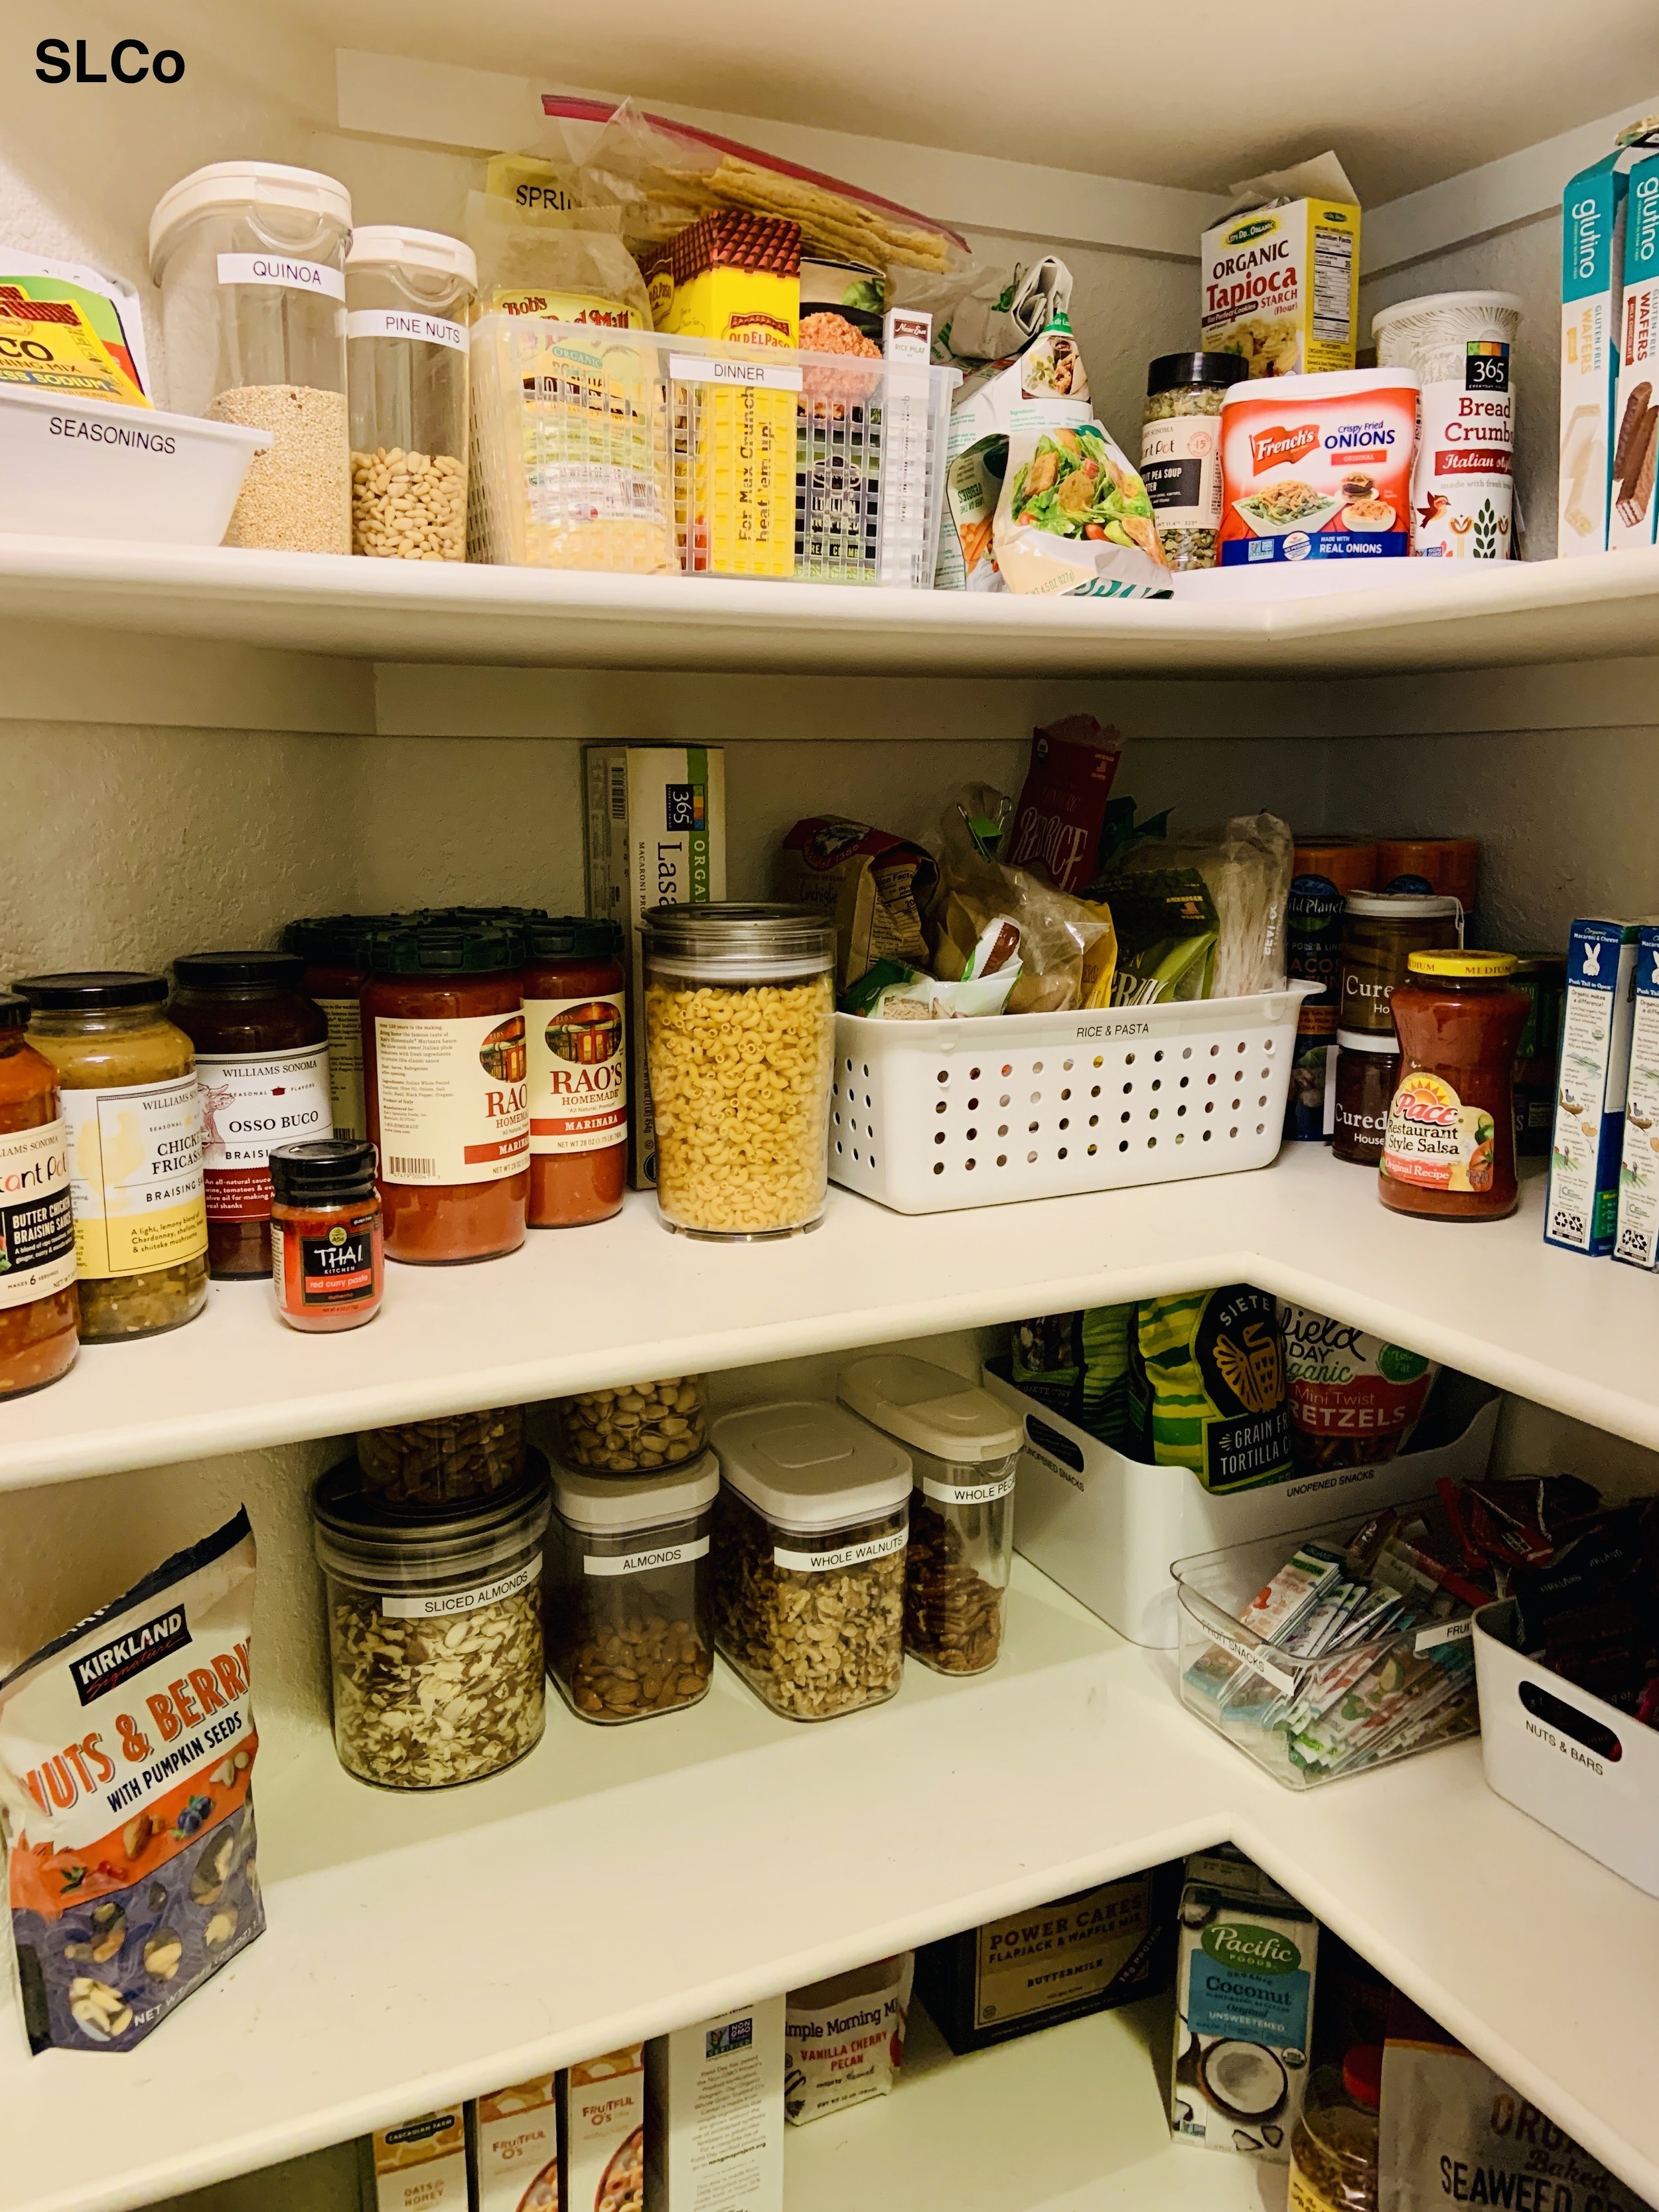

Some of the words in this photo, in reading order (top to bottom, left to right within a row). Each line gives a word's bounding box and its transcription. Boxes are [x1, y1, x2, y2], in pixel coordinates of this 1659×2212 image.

[1338, 235, 1351, 244] Facts
[1572, 198, 1601, 279] glutino
[1213, 240, 1289, 279] ORGANIC
[252, 261, 322, 286] QUINOA
[1206, 267, 1297, 322] Tapioca
[1261, 289, 1297, 309] STARCH
[1274, 303, 1298, 316] (Flour)
[386, 316, 421, 334] PINE
[426, 323, 461, 344] NUTS
[1637, 291, 1651, 361] WAFERS
[895, 344, 908, 353] RICE
[910, 345, 926, 354] PILAF
[1581, 307, 1593, 374] WAFERS
[46, 363, 82, 373] MIX
[715, 364, 764, 381] DINNER
[1473, 358, 1505, 383] 365
[32, 373, 109, 391] SODIUM
[1459, 398, 1511, 419] Bread
[49, 416, 177, 455] SEASONINGS
[1338, 424, 1362, 434] Crispy
[1364, 420, 1384, 430] Fried
[1445, 421, 1515, 443] Crumbs
[1156, 440, 1175, 455] Pot
[1256, 429, 1316, 461] French's
[1325, 429, 1395, 449] ONIONS
[1442, 452, 1494, 470] Italian
[1151, 469, 1162, 480] PEA
[1163, 467, 1182, 479] SOUP
[1467, 479, 1484, 488] with
[1319, 544, 1344, 553] REAL
[1346, 542, 1382, 554] ONIONS
[673, 790, 692, 824] 365
[1305, 900, 1344, 914] Planet
[1573, 932, 1596, 941] Macaroni
[1465, 966, 1512, 975] MEDIUM
[1076, 1025, 1103, 1038] RICE
[1105, 1025, 1112, 1035] &
[1115, 1023, 1149, 1035] PASTA
[223, 1066, 280, 1078] WILLIAMS
[283, 1060, 318, 1074] SONOMA
[549, 1061, 623, 1095] RAO'S
[291, 1083, 315, 1092] FLAVORS
[561, 1088, 619, 1106] HOMEMADE
[143, 1093, 190, 1112] WILLIAMS
[1394, 1092, 1460, 1127] Pace
[149, 1121, 182, 1132] SEASONAL
[229, 1118, 277, 1133] OSSO
[281, 1110, 319, 1129] BUCO
[564, 1114, 618, 1132] MARINARA
[1334, 1102, 1388, 1130] Cured
[1388, 1119, 1459, 1140] Restaurant
[30, 1135, 58, 1152] SONOMA
[1388, 1134, 1414, 1152] Style
[1417, 1138, 1460, 1155] Salsa
[1385, 1158, 1412, 1173] Original
[1413, 1165, 1450, 1181] Recipe
[146, 1181, 196, 1203] BRAISING
[244, 1192, 269, 1201] making
[12, 1206, 47, 1229] BUTTER
[160, 1220, 182, 1232] lemony
[13, 1219, 55, 1246] BRAISING
[131, 1230, 177, 1245] Chardonnay,
[141, 1241, 168, 1252] shiitake
[314, 1244, 363, 1268] THAI
[324, 1265, 356, 1275] KITCHEN
[8, 1280, 28, 1290] MAKES
[30, 1274, 36, 1286] 6
[310, 1280, 324, 1289] red
[325, 1278, 346, 1290] curry
[347, 1274, 368, 1287] paste
[1220, 1295, 1271, 1327] SIETE
[1289, 1342, 1331, 1364] DAY
[1295, 1384, 1327, 1404] Mini
[1333, 1392, 1376, 1406] Twist
[1287, 1402, 1406, 1428] RETZELS
[1235, 1420, 1272, 1449] GRAIN
[1220, 1441, 1279, 1476] TORTILLA
[1059, 1469, 1085, 1493] SNACKS
[1287, 1478, 1337, 1498] UNOPENED
[1338, 1469, 1374, 1485] SNACKS
[954, 1487, 995, 1501] WHOLE
[622, 1549, 682, 1570] ALMONDS
[810, 1551, 852, 1567] WHOLE
[855, 1535, 903, 1558] WALNUTS
[424, 1595, 474, 1613] SLICED
[477, 1570, 529, 1602] ALMONDS
[79, 1612, 183, 1685] KIRKLAND
[1229, 1640, 1265, 1673] SNACKS
[115, 1714, 155, 1763] &
[1526, 1720, 1556, 1748] NUTS
[1559, 1741, 1567, 1754] &
[1570, 1745, 1604, 1777] BARS
[107, 1777, 141, 1814] WITH
[143, 1737, 205, 1792] PUMPKIN
[205, 1711, 243, 1749] SEEDS
[989, 1918, 1069, 1951] POWER
[1075, 1893, 1143, 1926] CAKES
[988, 1939, 1052, 1964] FLAPJACK
[1056, 1936, 1065, 1947] &
[1068, 1922, 1115, 1944] WAFFLE
[1211, 1927, 1293, 1962] Pacific
[1027, 1958, 1104, 1988] BUTTERMILK
[1206, 1976, 1291, 2006] Coconut
[134, 2004, 162, 2027] NET
[731, 2020, 751, 2031] NON
[827, 2008, 882, 2037] Morning
[1208, 2012, 1285, 2033] UNSWEETENED
[731, 2026, 751, 2037] GMO
[800, 2043, 848, 2062] VANILLA
[849, 2030, 888, 2053] CHERRY
[830, 2053, 864, 2072] PECAN
[583, 2096, 634, 2118] FRUITFUL
[492, 2130, 547, 2153] FRUITFUL
[404, 2182, 434, 2198] OATS
[1439, 2154, 1573, 2212] SEAWEED
[404, 2189, 445, 2207] HONEY
